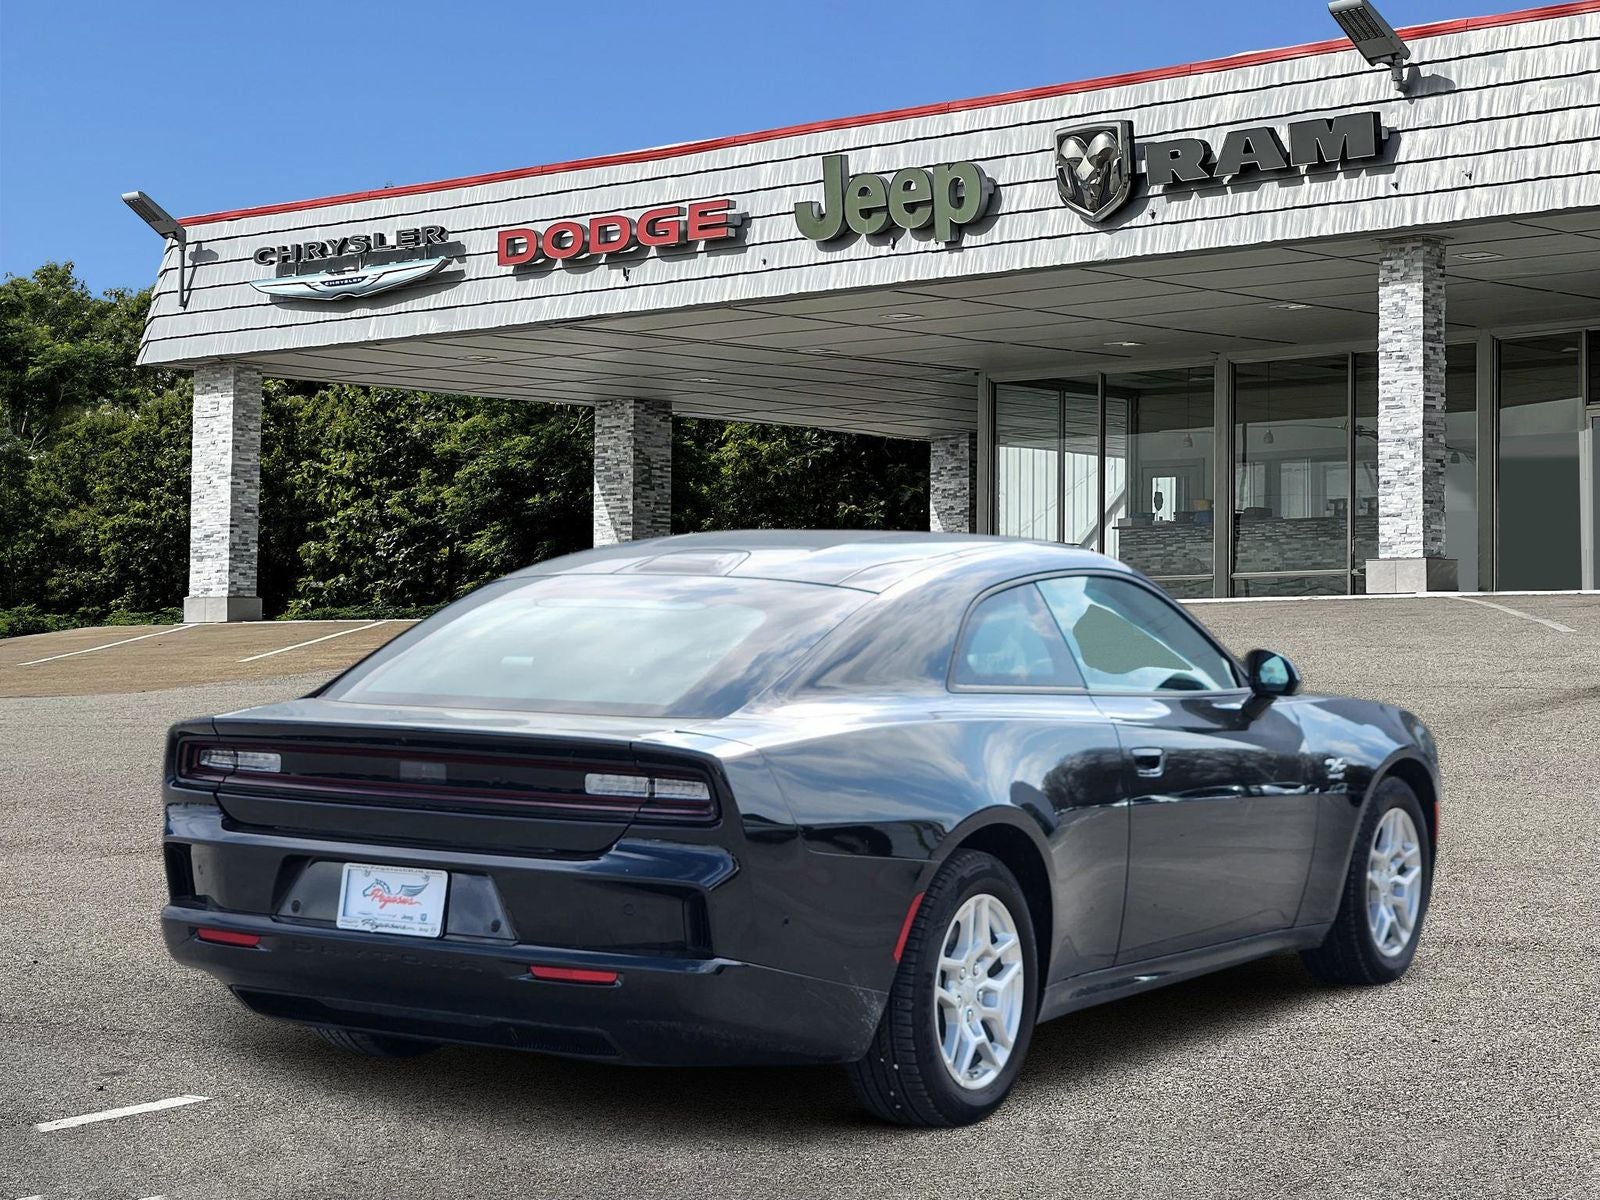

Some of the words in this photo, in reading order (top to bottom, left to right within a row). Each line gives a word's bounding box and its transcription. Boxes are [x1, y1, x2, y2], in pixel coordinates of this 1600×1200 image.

[1146, 111, 1381, 186] RAM
[795, 155, 988, 242] Jeep
[253, 225, 448, 266] CHRYSLER
[497, 199, 736, 267] DODGE
[324, 277, 363, 286] CHRYSLER
[370, 887, 422, 909] Pegasus
